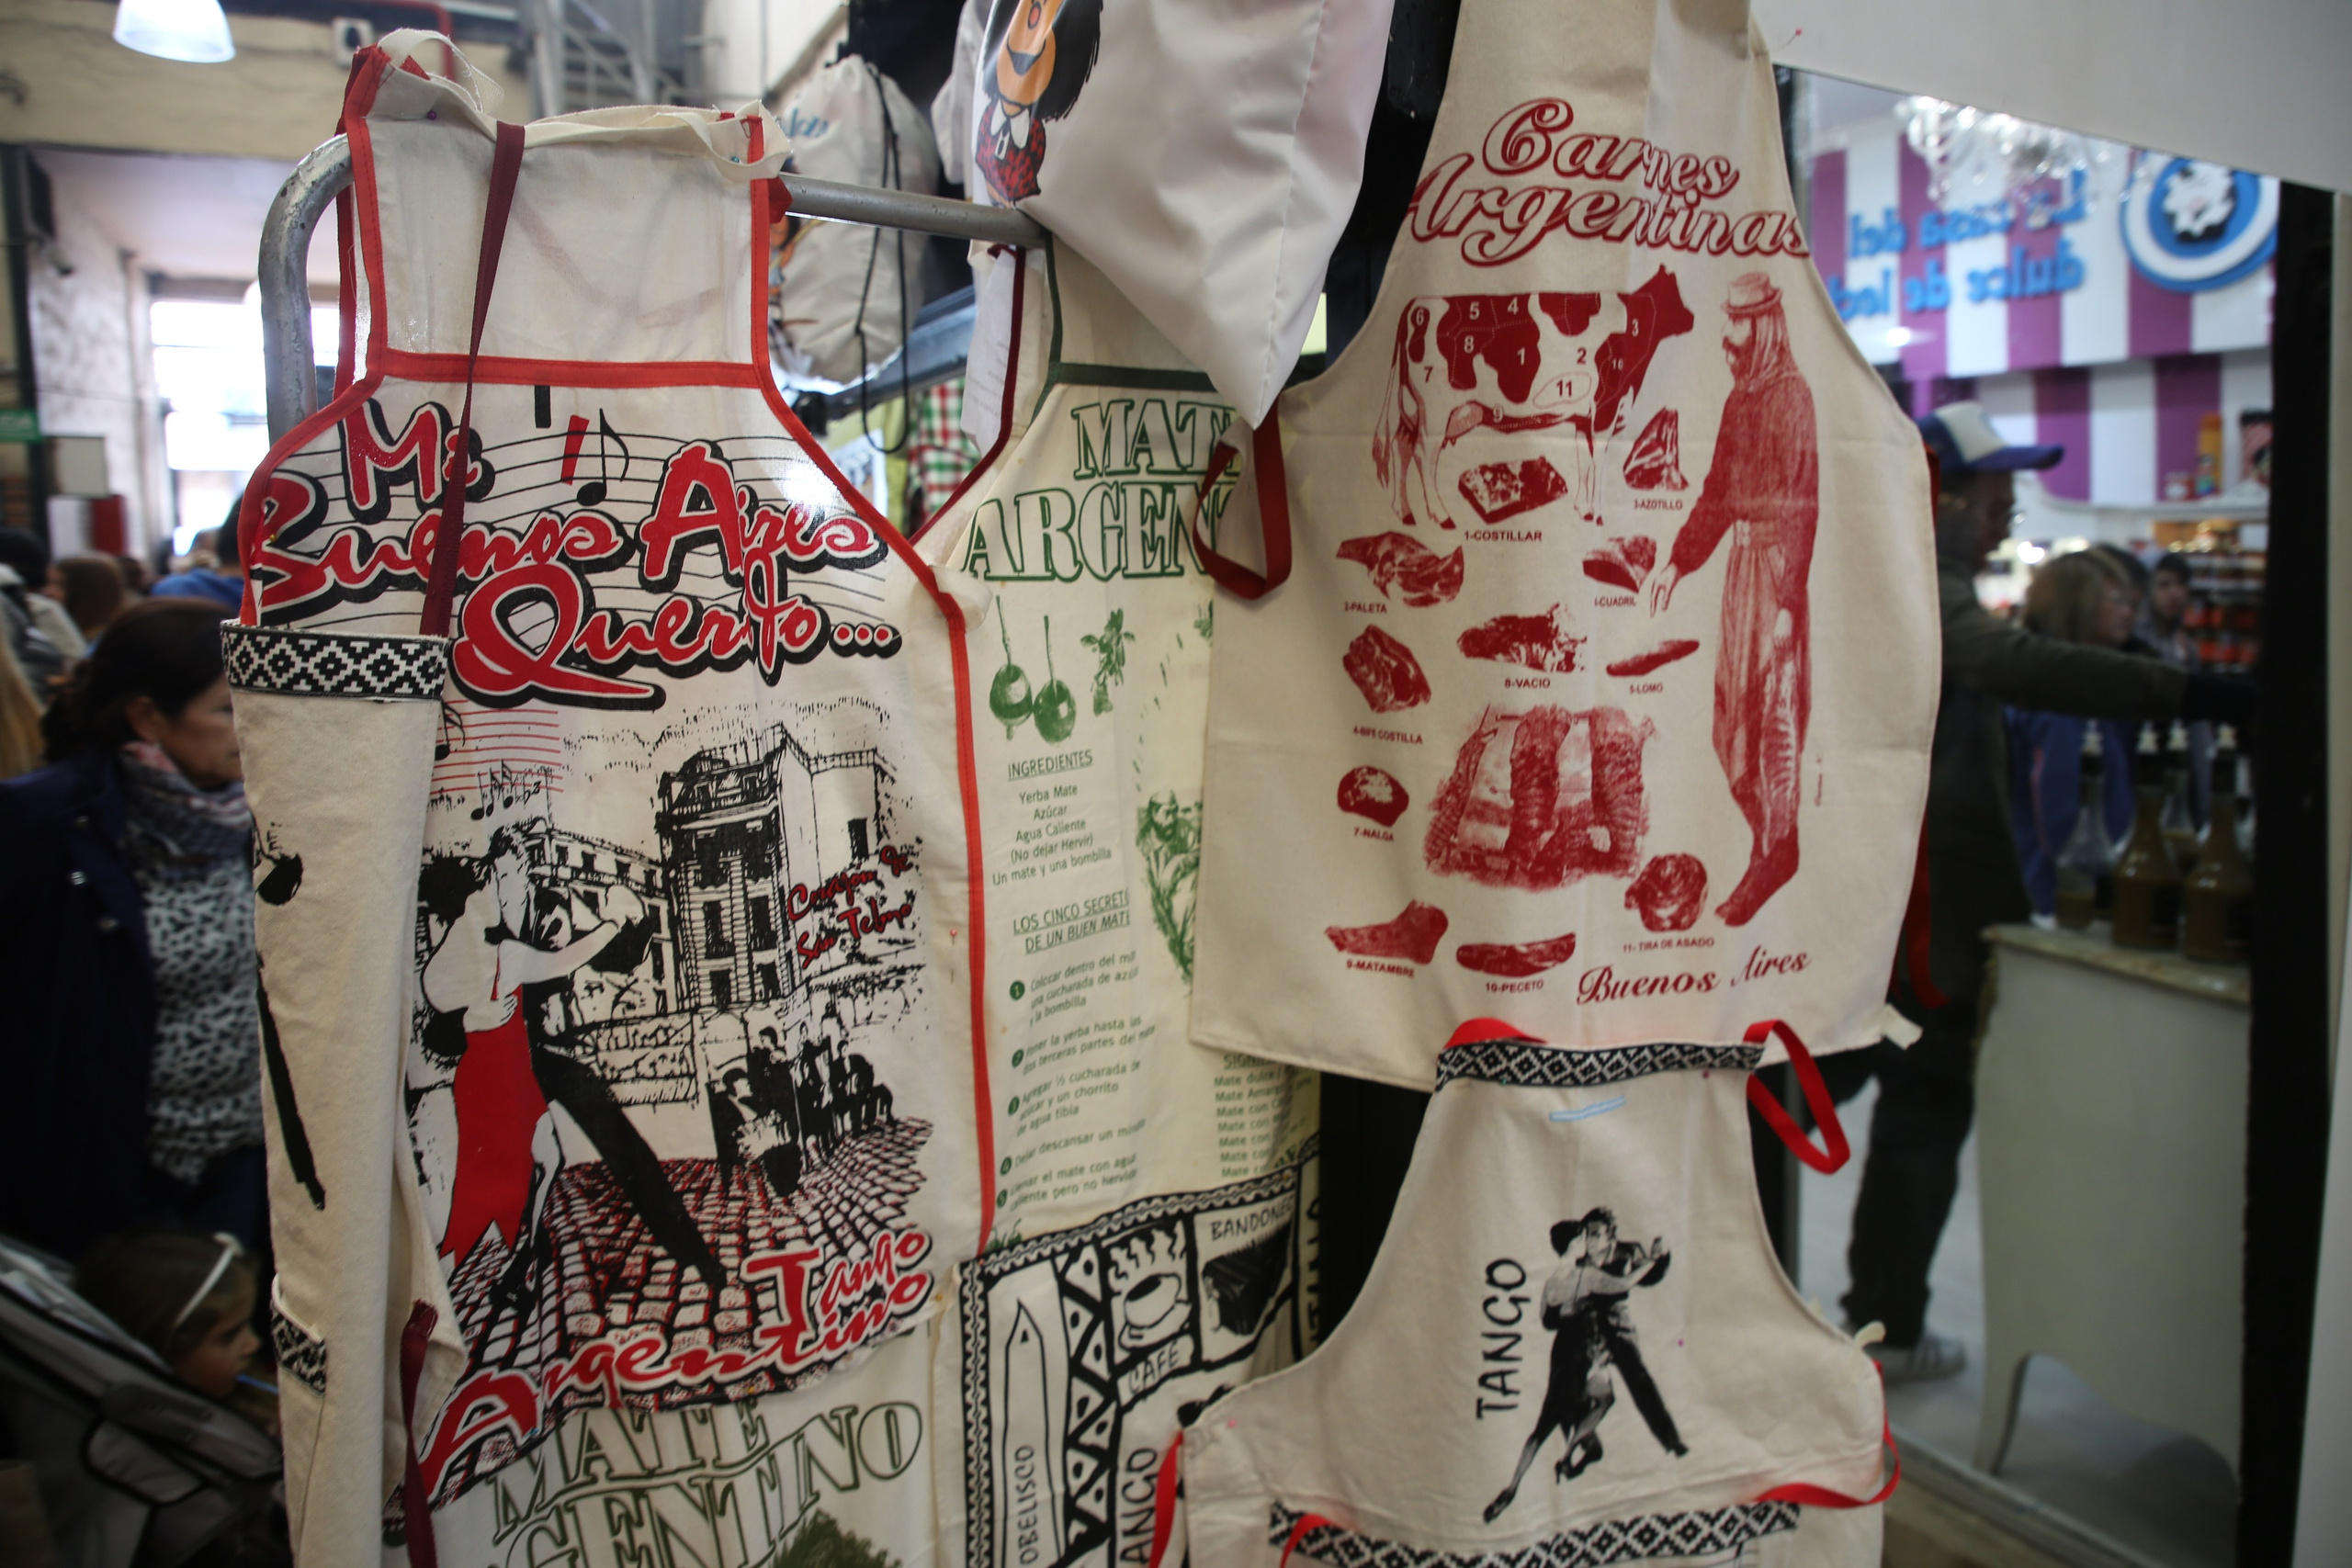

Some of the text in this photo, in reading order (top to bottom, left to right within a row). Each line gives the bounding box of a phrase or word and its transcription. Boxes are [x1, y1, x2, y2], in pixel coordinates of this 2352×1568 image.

[1482, 97, 1739, 199] Carnes
[1405, 153, 1811, 267] Argentinas
[1415, 310, 1424, 324] 6
[1469, 304, 1481, 320] 5
[1508, 300, 1519, 315] 4
[1632, 319, 1639, 336] 3
[1464, 337, 1475, 354] 8
[1517, 350, 1525, 365] 1
[1577, 348, 1587, 365] 2
[1424, 367, 1433, 382] 7
[1556, 381, 1573, 397] 11
[637, 439, 888, 592] Aires
[1464, 530, 1543, 542] 1-COSTILLAR
[1378, 728, 1423, 745] COSTILLA
[1008, 750, 1093, 780] INGREDIENTES
[1020, 784, 1078, 805] Yerba Mate
[1034, 806, 1068, 821] Azúcar
[1016, 819, 1086, 844] Agua Caliente
[1011, 848, 1029, 864] (No
[1033, 842, 1057, 860] dejar
[992, 874, 1007, 886] Un
[1012, 866, 1036, 881] mate
[1049, 861, 1068, 874] una
[1071, 847, 1112, 866] bombilla
[1013, 912, 1039, 933] LOS
[1044, 903, 1080, 926] CINCO
[1025, 936, 1041, 953] DE
[1046, 930, 1063, 947] UN
[1069, 919, 1097, 941] BUEN
[1577, 964, 1721, 1006] Buenos
[1476, 1258, 1531, 1420] TANGO
[1014, 1446, 1039, 1565] OBELISCO
